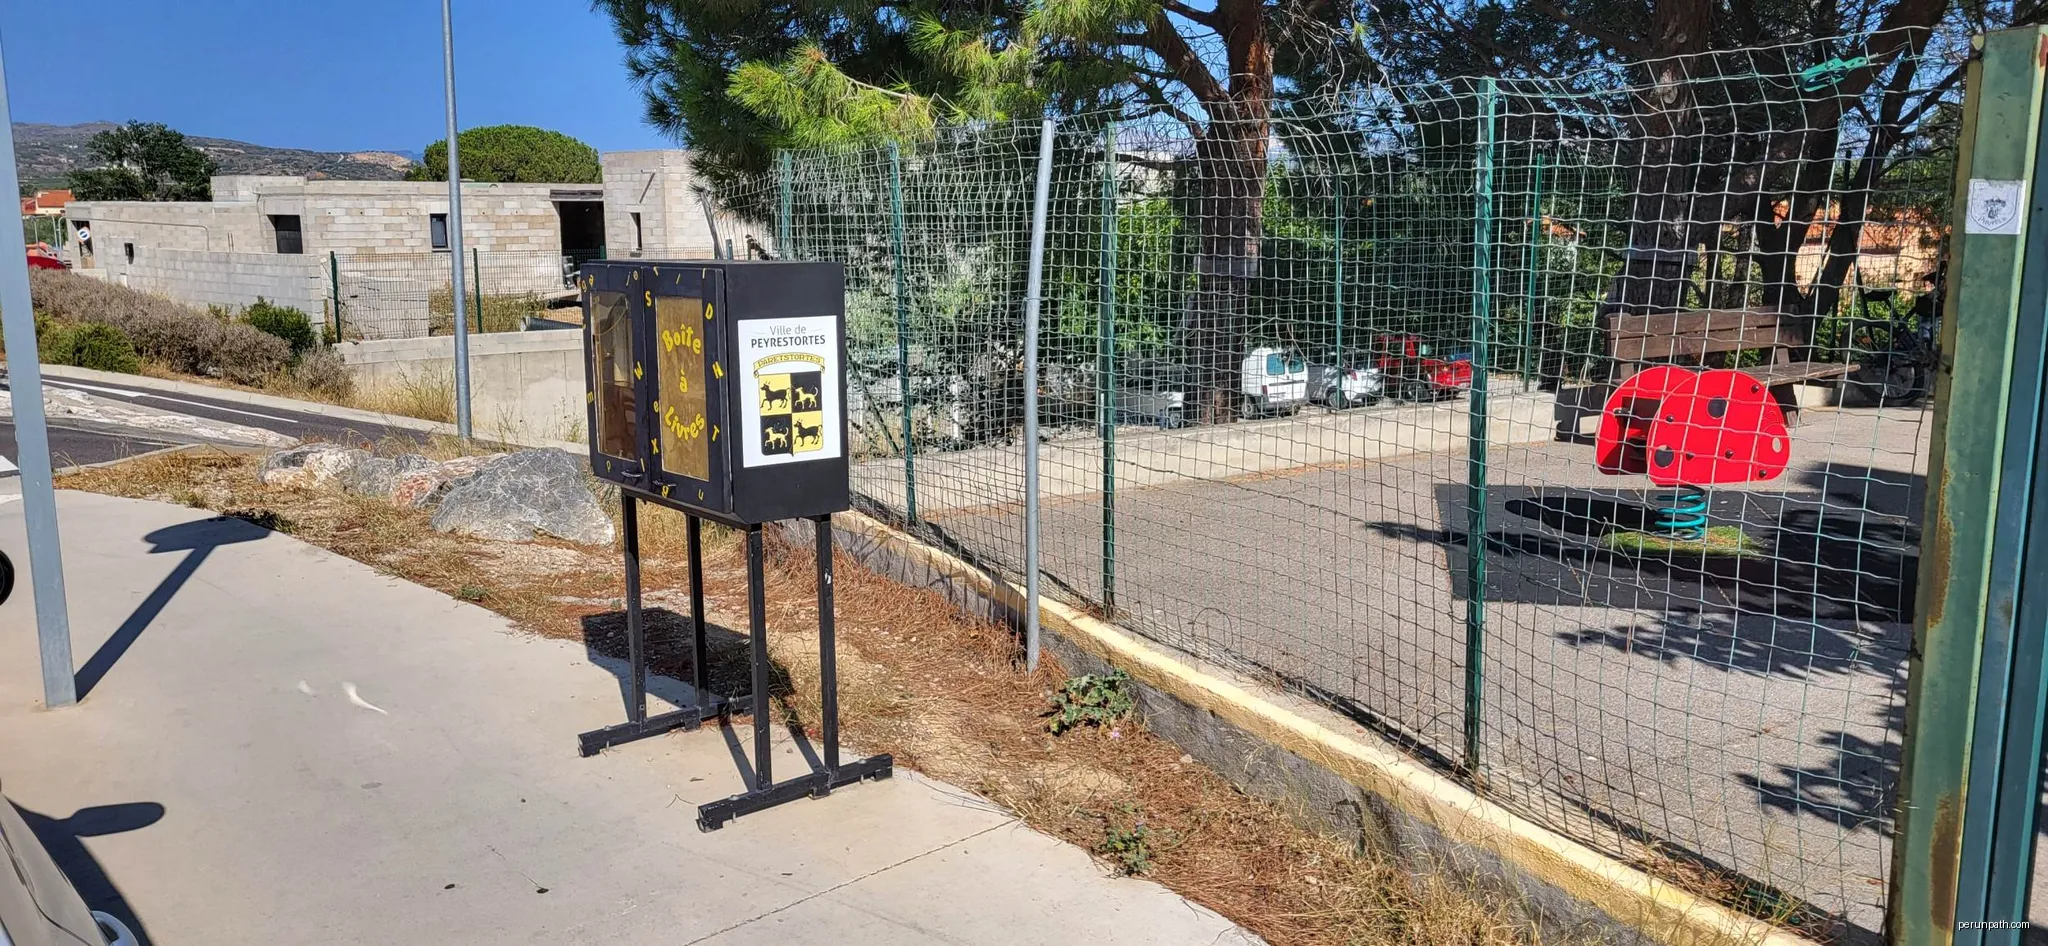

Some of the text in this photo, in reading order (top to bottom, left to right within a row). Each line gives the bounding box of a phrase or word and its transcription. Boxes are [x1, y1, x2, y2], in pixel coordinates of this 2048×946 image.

[705, 302, 714, 320] D
[662, 323, 702, 355] Boîte
[769, 324, 807, 336] Ville de
[751, 335, 826, 348] PEYRESTORTES
[679, 370, 688, 393] à
[664, 406, 705, 440] Livres
